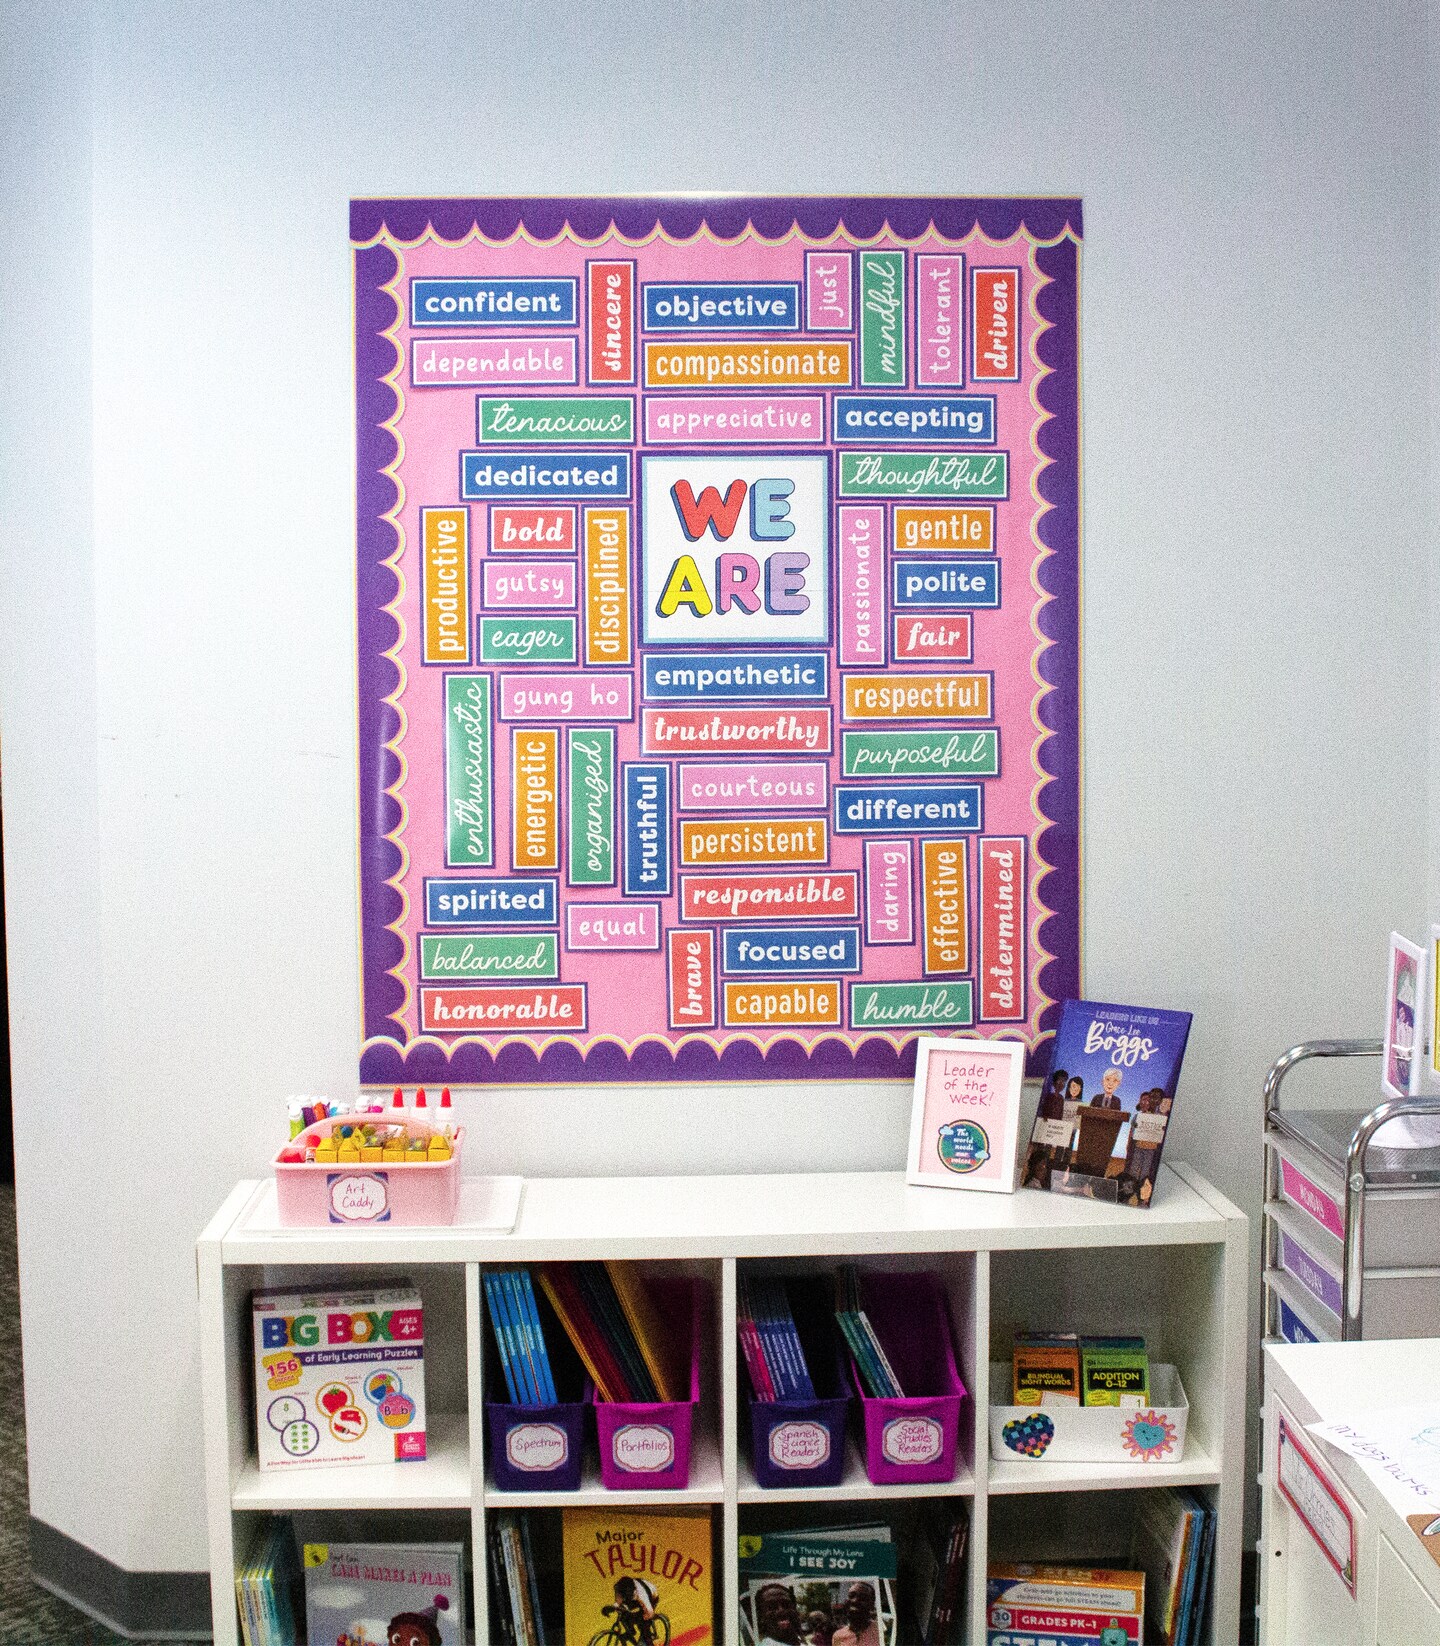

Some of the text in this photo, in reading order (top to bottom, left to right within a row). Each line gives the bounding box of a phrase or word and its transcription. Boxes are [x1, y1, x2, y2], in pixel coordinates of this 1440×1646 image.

[425, 291, 561, 314] confident
[816, 265, 843, 317] just
[602, 273, 621, 371] sincere
[655, 295, 788, 322] objective
[867, 261, 902, 375] mindful
[929, 267, 952, 373] tolerant
[984, 280, 1008, 369] driven
[423, 348, 564, 377] dependable
[656, 350, 841, 381] compassionate
[487, 403, 627, 432] tenacious
[657, 404, 812, 433] appreciative
[846, 407, 983, 433] accepting
[475, 465, 618, 486] dedicated
[848, 457, 997, 492] thoughtful
[670, 478, 796, 542] WE
[503, 517, 564, 543] bold
[905, 513, 982, 547] gentle
[431, 519, 464, 652] productive
[496, 570, 564, 600] gutsy
[593, 517, 625, 653] disciplined
[655, 552, 810, 618] ARE
[848, 518, 876, 653] passionate
[906, 571, 986, 597] polite
[492, 630, 564, 656] eager
[907, 622, 960, 651] fair
[655, 664, 816, 691] empathetic
[513, 683, 619, 713] gung ho
[854, 681, 980, 713] respectful
[655, 717, 819, 746] trustworthy
[853, 733, 987, 772] purposeful
[454, 681, 484, 855] enthusiastic
[520, 741, 553, 857] energetic
[691, 775, 815, 797] courteous
[572, 741, 609, 872] organized
[847, 798, 970, 820] different
[637, 775, 658, 882] truthful
[691, 827, 817, 859] persistent
[438, 889, 545, 916] spirited
[693, 878, 846, 915] responsible
[876, 850, 906, 931] daring
[933, 850, 959, 962] effective
[579, 914, 646, 941] equal
[989, 849, 1014, 1009] determined
[432, 942, 547, 970] balanced
[738, 940, 846, 962] focused
[679, 941, 702, 1016] brave
[433, 994, 573, 1021] honorable
[735, 989, 830, 1019] capable
[863, 991, 961, 1020] humble
[1084, 1020, 1159, 1067] Boggs
[943, 1060, 995, 1078] Leader
[944, 1078, 988, 1093] of the
[949, 1092, 994, 1107] week!
[342, 1196, 374, 1210] Caddy
[346, 1183, 365, 1194] Art
[262, 1311, 394, 1349] BIG BOX
[401, 1324, 417, 1335] 4+
[266, 1358, 298, 1377] 156
[305, 1348, 418, 1365] of Early Learning Puzzles
[1093, 1372, 1140, 1380] ADDITION
[779, 1429, 819, 1441] Spanish
[896, 1434, 932, 1444] Studies
[901, 1424, 928, 1435] Social
[515, 1438, 562, 1453] Spectrum
[621, 1439, 668, 1452] Portfolios
[781, 1447, 820, 1458] Readers
[897, 1443, 932, 1453] Readers
[596, 1529, 644, 1544] Major
[782, 1546, 798, 1554] Life
[800, 1547, 831, 1558] Through
[833, 1549, 845, 1557] My
[789, 1557, 856, 1569] I SEE JOY
[584, 1543, 704, 1591] TAYLOR
[1021, 1615, 1068, 1628] GRADES
